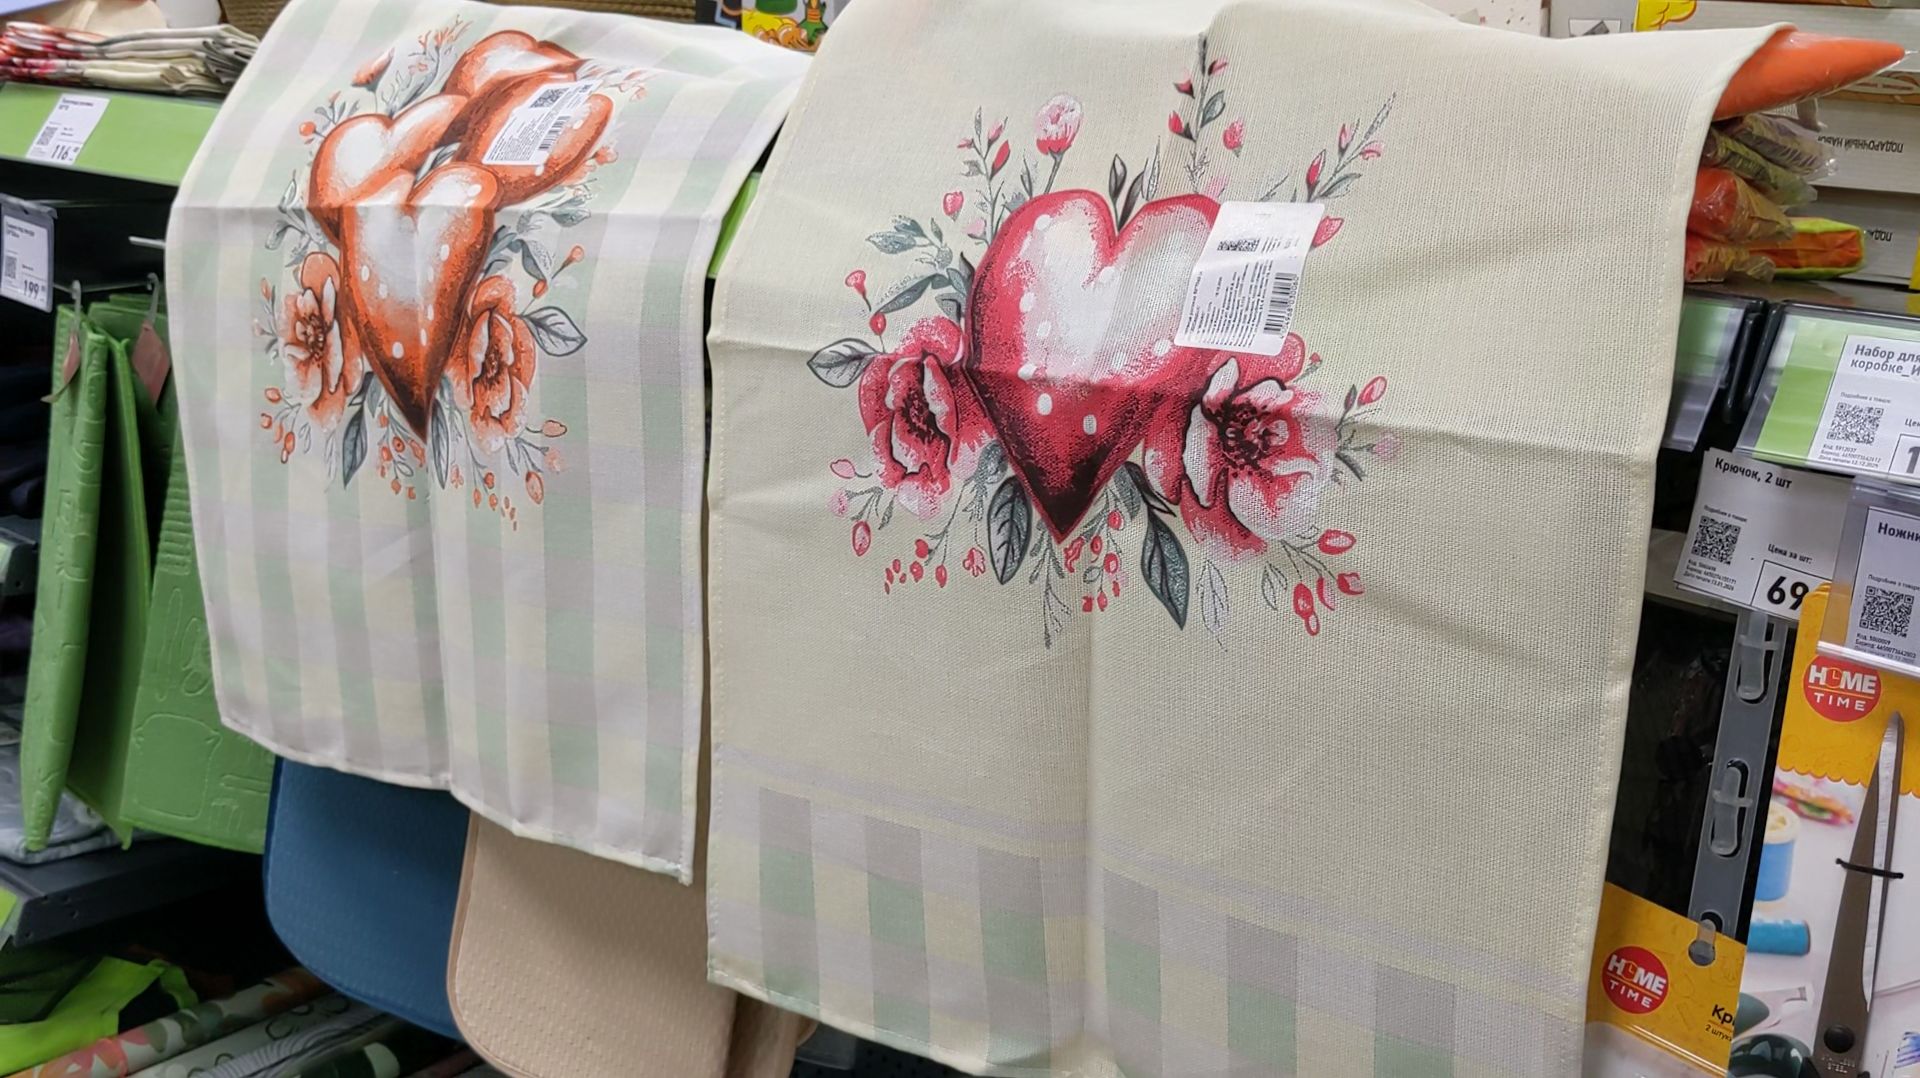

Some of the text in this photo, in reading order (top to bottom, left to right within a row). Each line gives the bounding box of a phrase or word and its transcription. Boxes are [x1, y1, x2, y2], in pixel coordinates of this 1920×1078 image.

[1854, 344, 1895, 362] Набор
[1715, 457, 1792, 489] Крючок, 2 шт
[1878, 522, 1920, 542] Ножни
[1767, 575, 1809, 611] 69
[1808, 664, 1877, 694] HOME
[1814, 691, 1866, 712] TIME
[1607, 954, 1667, 996] HOME
[1610, 979, 1653, 1009] TIME
[1712, 1004, 1734, 1026] Кр
